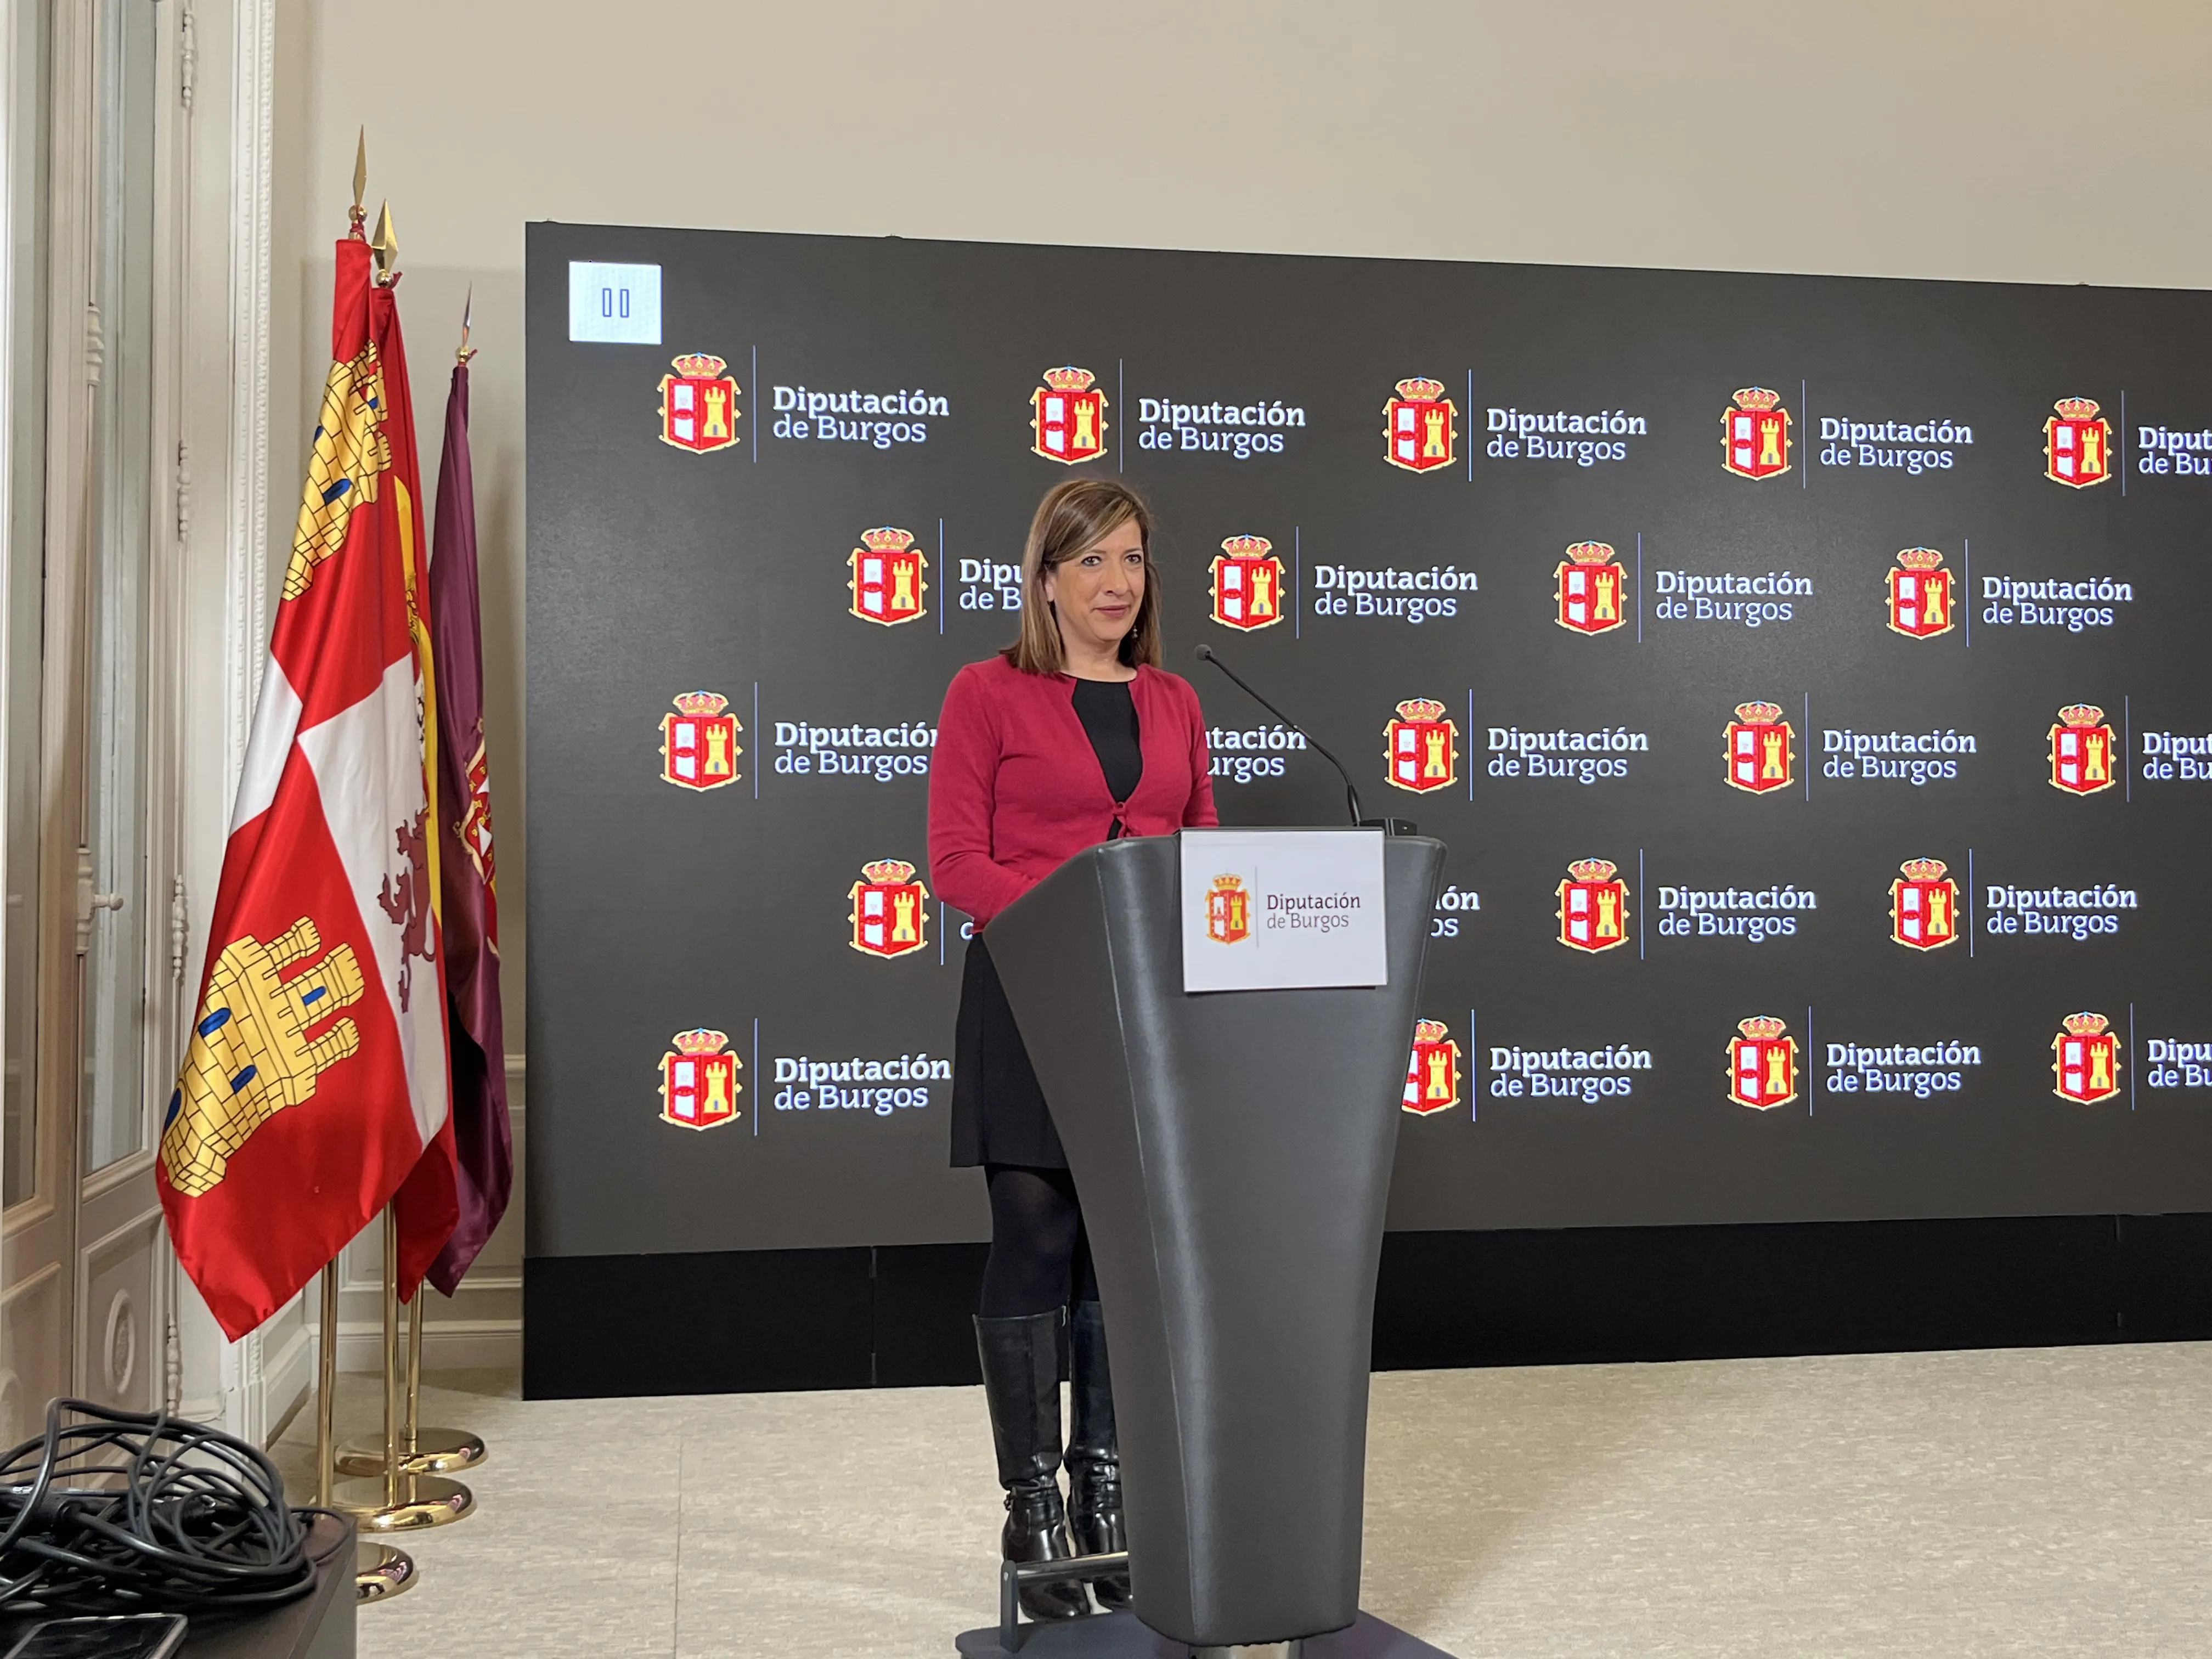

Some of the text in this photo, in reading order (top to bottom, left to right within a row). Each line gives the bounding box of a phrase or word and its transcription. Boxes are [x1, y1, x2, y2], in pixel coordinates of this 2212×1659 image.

[773, 386, 949, 419] Diputación
[1139, 398, 1305, 430] Diputación
[773, 413, 926, 449] de Burgos
[1487, 408, 1646, 438] Diputación
[1820, 417, 1973, 447] Diputación
[1139, 425, 1283, 459] de Burgos
[1487, 434, 1626, 466] de Burgos
[1821, 443, 1953, 475] de Burgos
[2139, 452, 2168, 473] de
[1315, 565, 1478, 595] Diputación
[1656, 570, 1813, 600] Diputación
[1982, 576, 2132, 606] Diputación
[960, 585, 994, 610] de
[1315, 591, 1457, 623] de Burgos
[1656, 596, 1793, 628] de Burgos
[1983, 601, 2113, 632] de Burgos
[1206, 725, 1306, 750] tación
[1488, 727, 1649, 758] Diputación
[1823, 729, 1976, 759] Diputación
[775, 749, 927, 782] de Burgos
[1488, 753, 1627, 784] de Burgos
[1824, 755, 1956, 785] de Burgos
[2143, 757, 2172, 778] de
[1267, 893, 1361, 915] Diputación
[1659, 885, 1816, 916] Diputación
[1987, 884, 2137, 915] Diputación
[1267, 913, 1349, 933] de Burgos
[1659, 912, 1796, 943] de Burgos
[1987, 911, 2118, 940] de Burgos
[1490, 1045, 1652, 1077] Diputación
[1827, 1040, 1981, 1073] Diputación
[775, 1054, 951, 1090] Diputación
[1827, 1069, 1961, 1098] de Burgos
[2148, 1064, 2179, 1087] de
[774, 1085, 928, 1115] de Burgos
[1491, 1073, 1631, 1103] de Burgos
